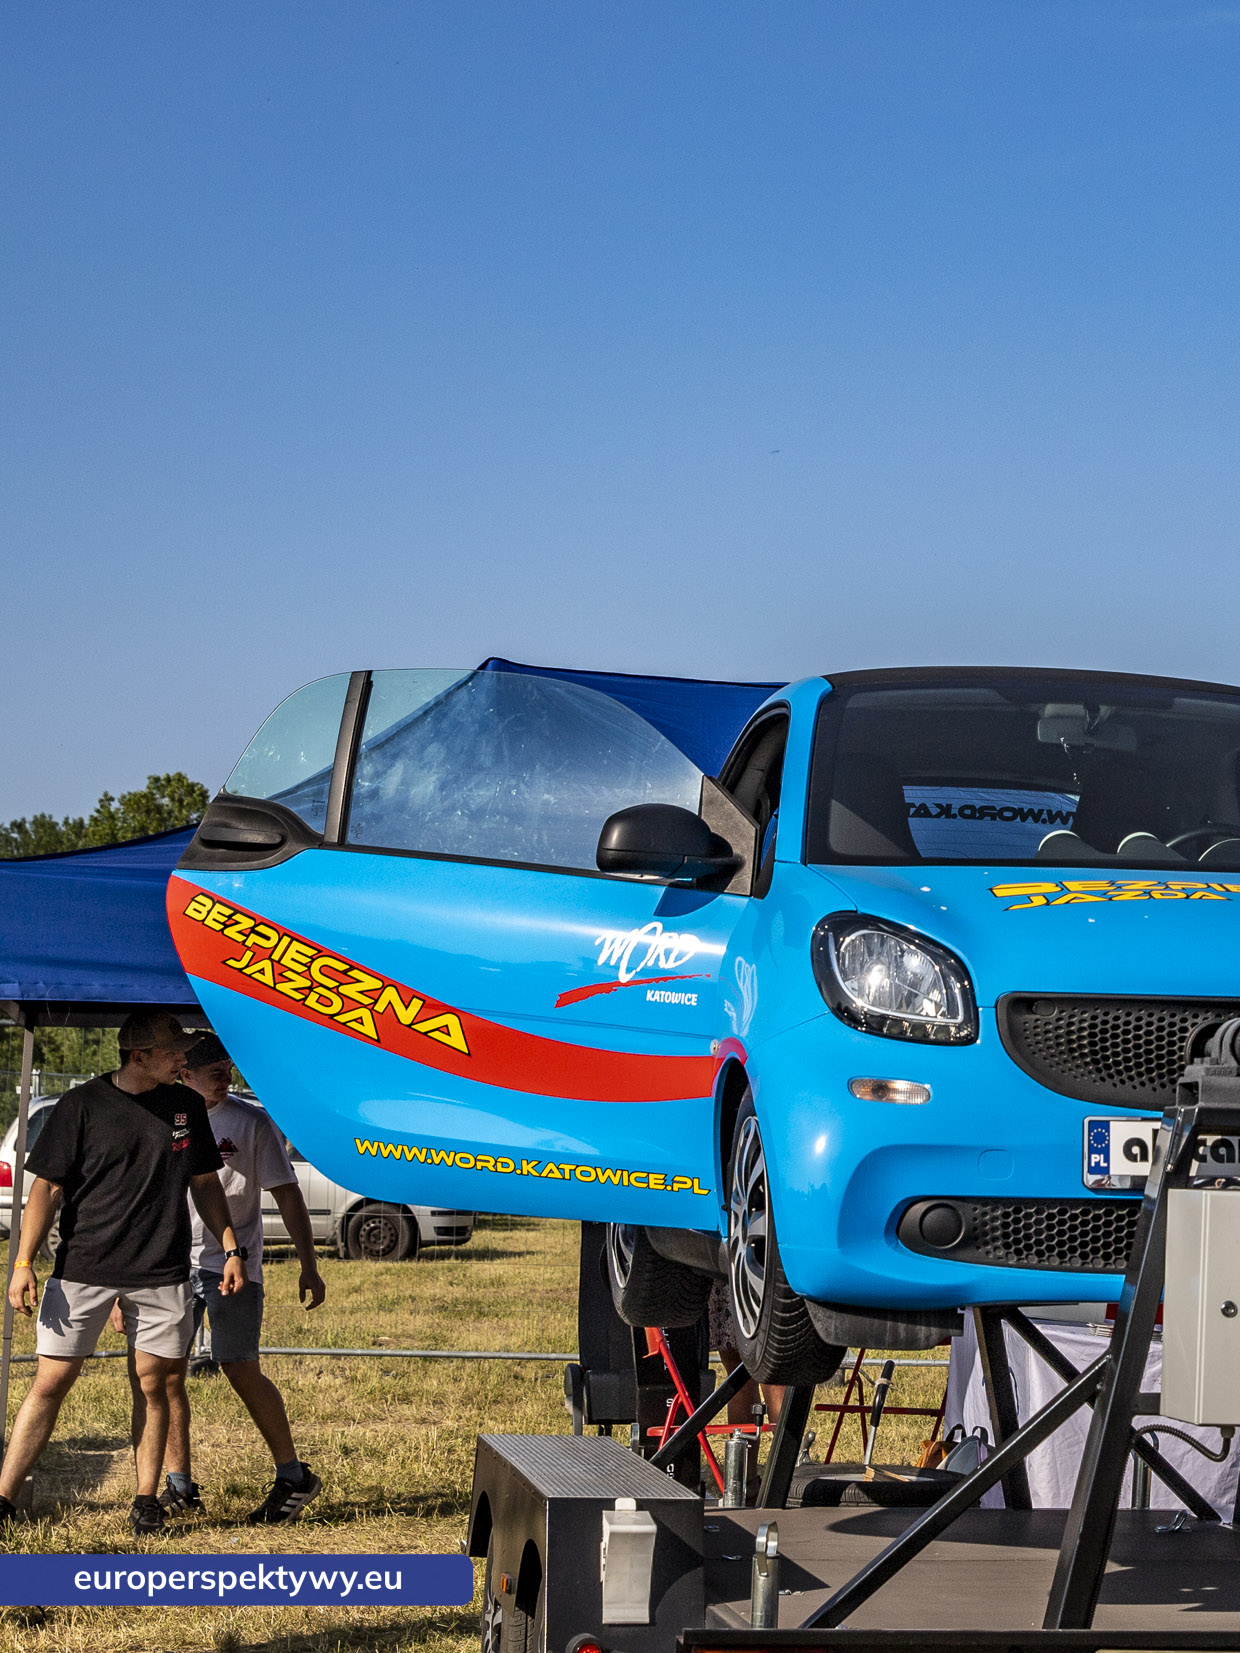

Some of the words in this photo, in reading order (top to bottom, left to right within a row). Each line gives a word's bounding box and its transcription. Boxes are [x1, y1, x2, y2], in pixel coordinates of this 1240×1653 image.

[1002, 891, 1233, 911] JAZDA
[594, 921, 700, 983] WORD
[184, 892, 471, 1057] BEZPIECZNA
[222, 950, 380, 1043] JAZDA
[646, 989, 698, 1006] KATOWICE
[174, 1113, 188, 1126] 95
[354, 1138, 711, 1195] WWW.WORD.KATOWICE.PL
[1091, 1154, 1108, 1167] PL
